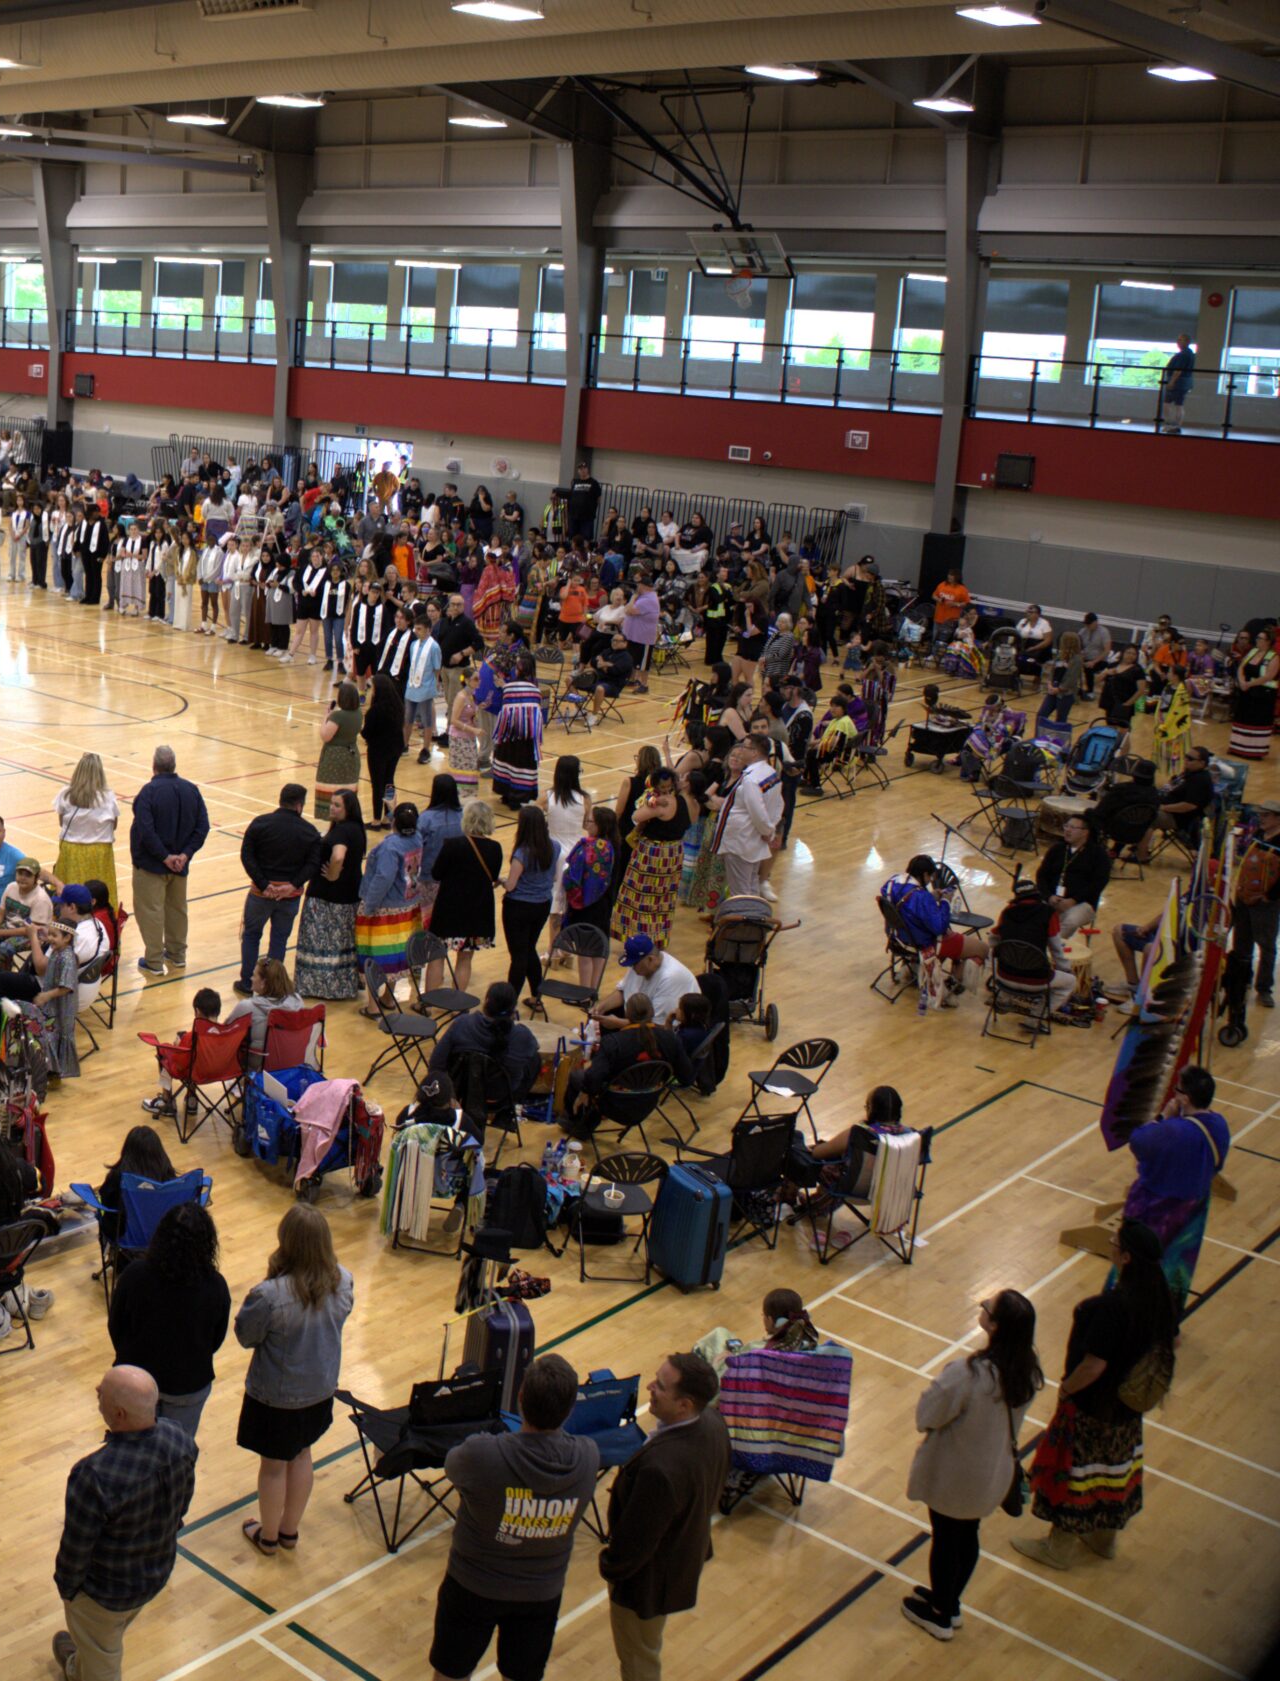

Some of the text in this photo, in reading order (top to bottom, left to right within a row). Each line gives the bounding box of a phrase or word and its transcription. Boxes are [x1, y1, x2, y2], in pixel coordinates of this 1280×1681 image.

[505, 1487, 534, 1500] OUR
[504, 1497, 580, 1520] UNION
[501, 1513, 550, 1529] MAKES
[498, 1521, 570, 1539] STRONGER
